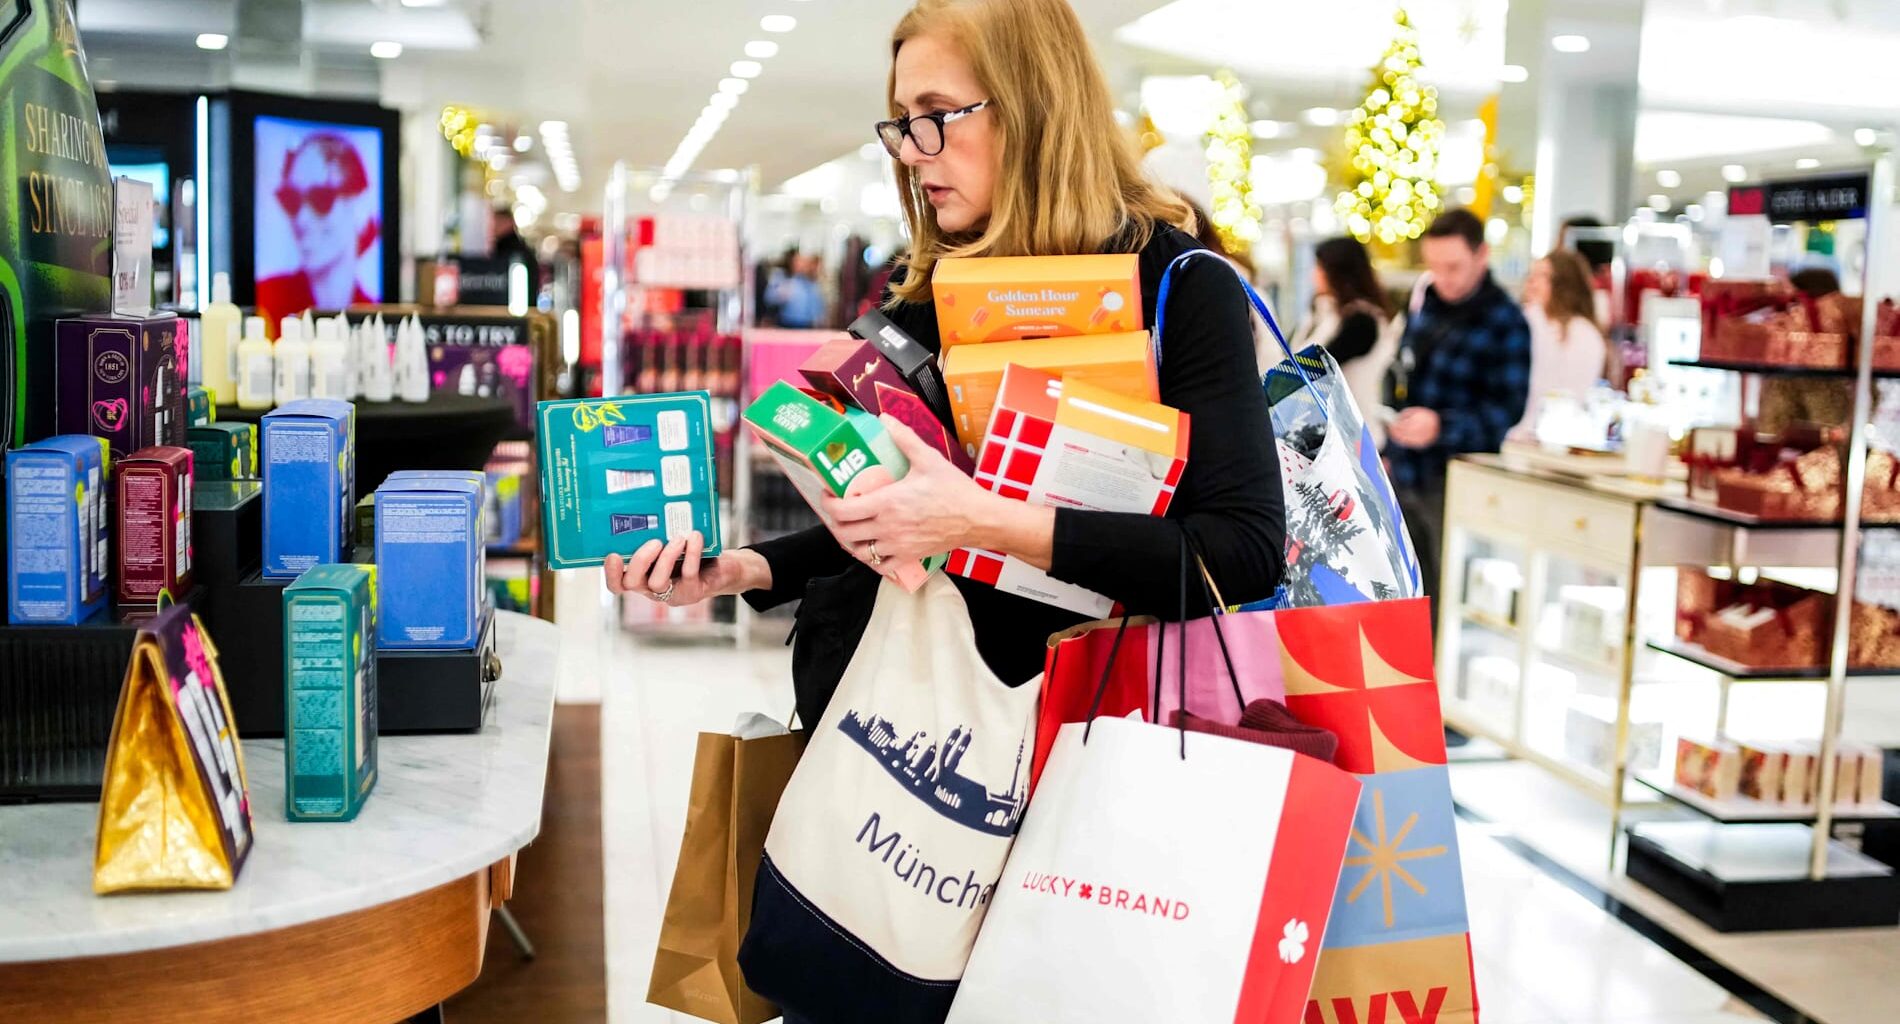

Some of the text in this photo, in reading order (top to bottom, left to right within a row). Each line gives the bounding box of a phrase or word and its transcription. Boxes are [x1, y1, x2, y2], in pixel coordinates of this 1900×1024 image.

[25, 102, 90, 165] SHARING
[29, 171, 85, 236] SINCE
[987, 288, 1079, 303] Golden Hour
[1005, 303, 1067, 317] Suncare
[817, 451, 833, 471] I
[830, 448, 867, 486] MB
[1022, 871, 1189, 920] LUCKY BRAND
[1303, 986, 1448, 1024] VY
